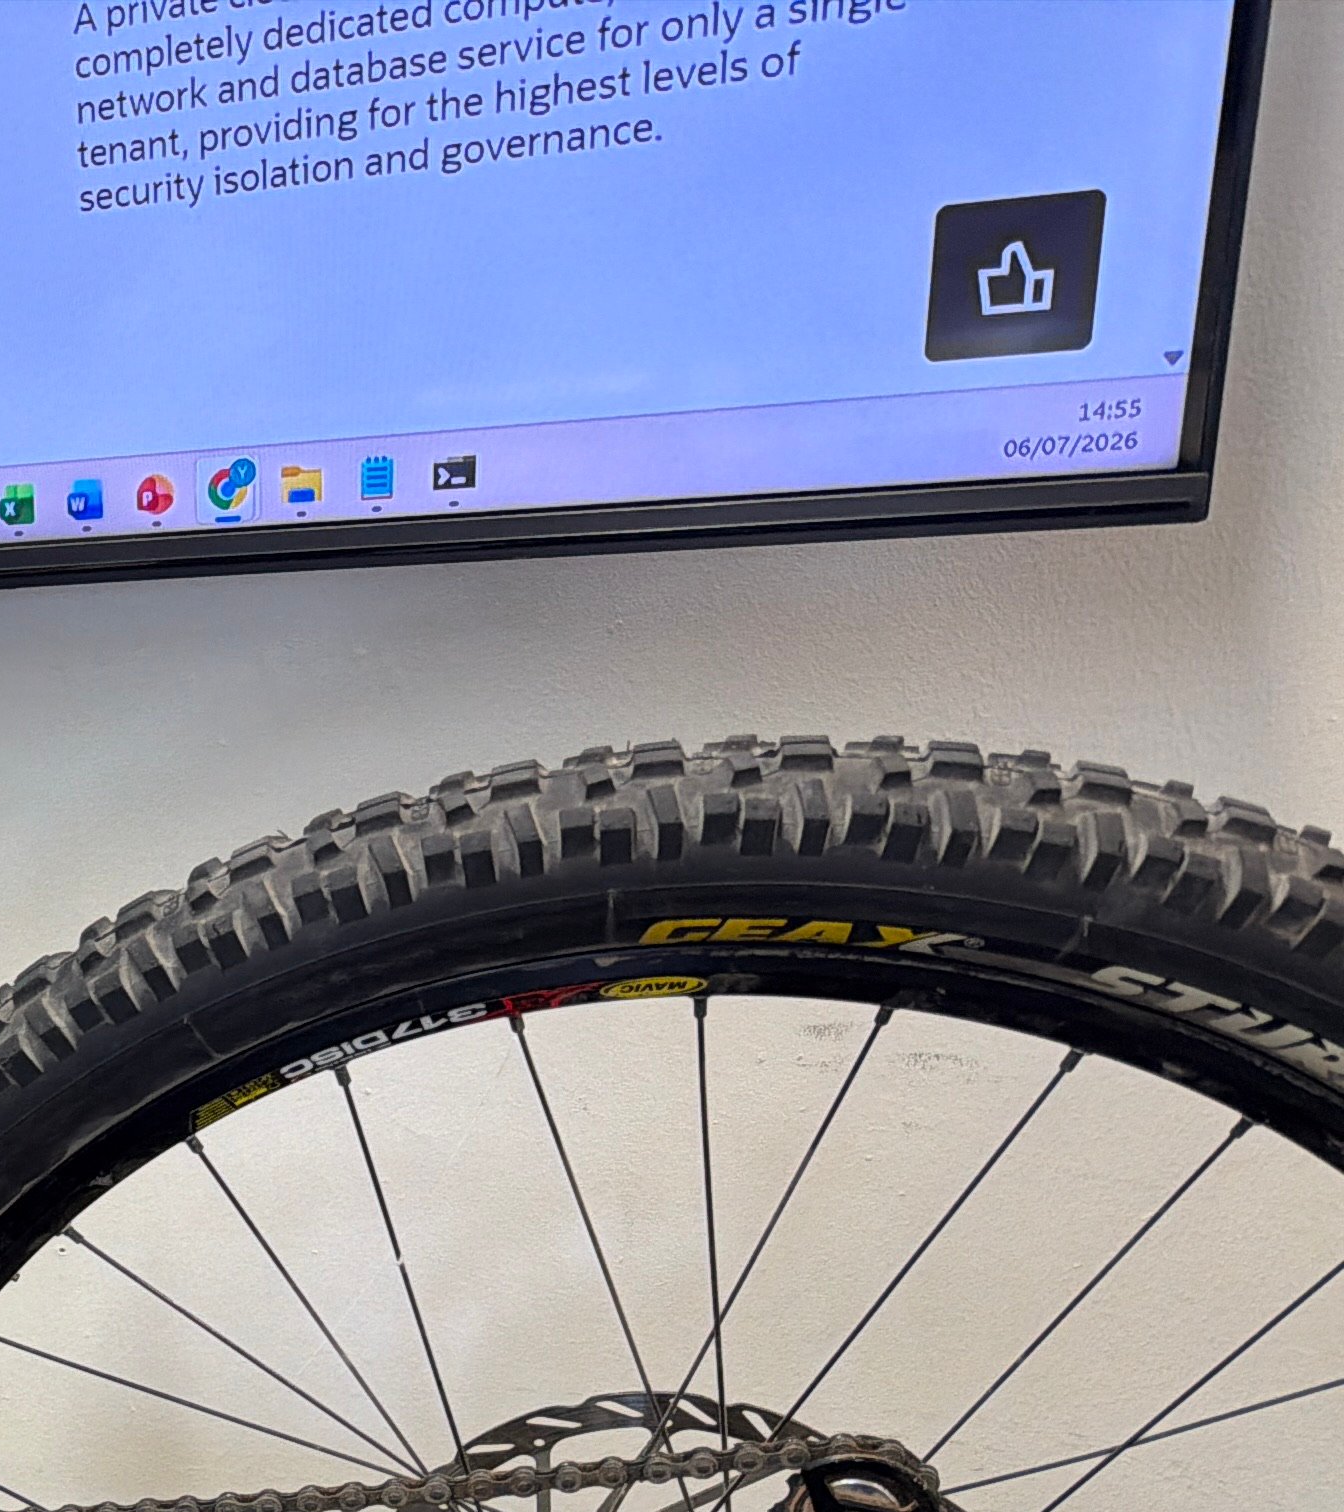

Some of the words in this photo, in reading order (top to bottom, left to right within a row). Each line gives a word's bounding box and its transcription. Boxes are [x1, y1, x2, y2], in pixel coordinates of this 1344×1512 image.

[72, 1, 97, 35] A
[75, 24, 252, 78] completely
[262, 0, 432, 50] dedicated
[76, 76, 207, 124] network
[217, 63, 279, 104] and
[290, 50, 447, 93] database
[457, 27, 585, 70] service
[597, 16, 649, 51] for
[660, 1, 744, 44] only
[754, 3, 775, 29] a
[76, 128, 188, 168] tenant,
[199, 107, 358, 159] providing
[367, 96, 416, 130] for
[425, 86, 483, 122] the
[495, 66, 630, 116] highest
[643, 50, 748, 93] levels
[760, 40, 801, 78] of
[79, 172, 204, 212] security
[214, 154, 353, 195] isolation
[364, 136, 429, 176] and
[441, 119, 661, 174] governance.
[1078, 397, 1141, 422] 14:55
[1002, 430, 1138, 458] 06/07/2026
[638, 917, 968, 956] GEAX
[618, 980, 688, 996] MAVIC
